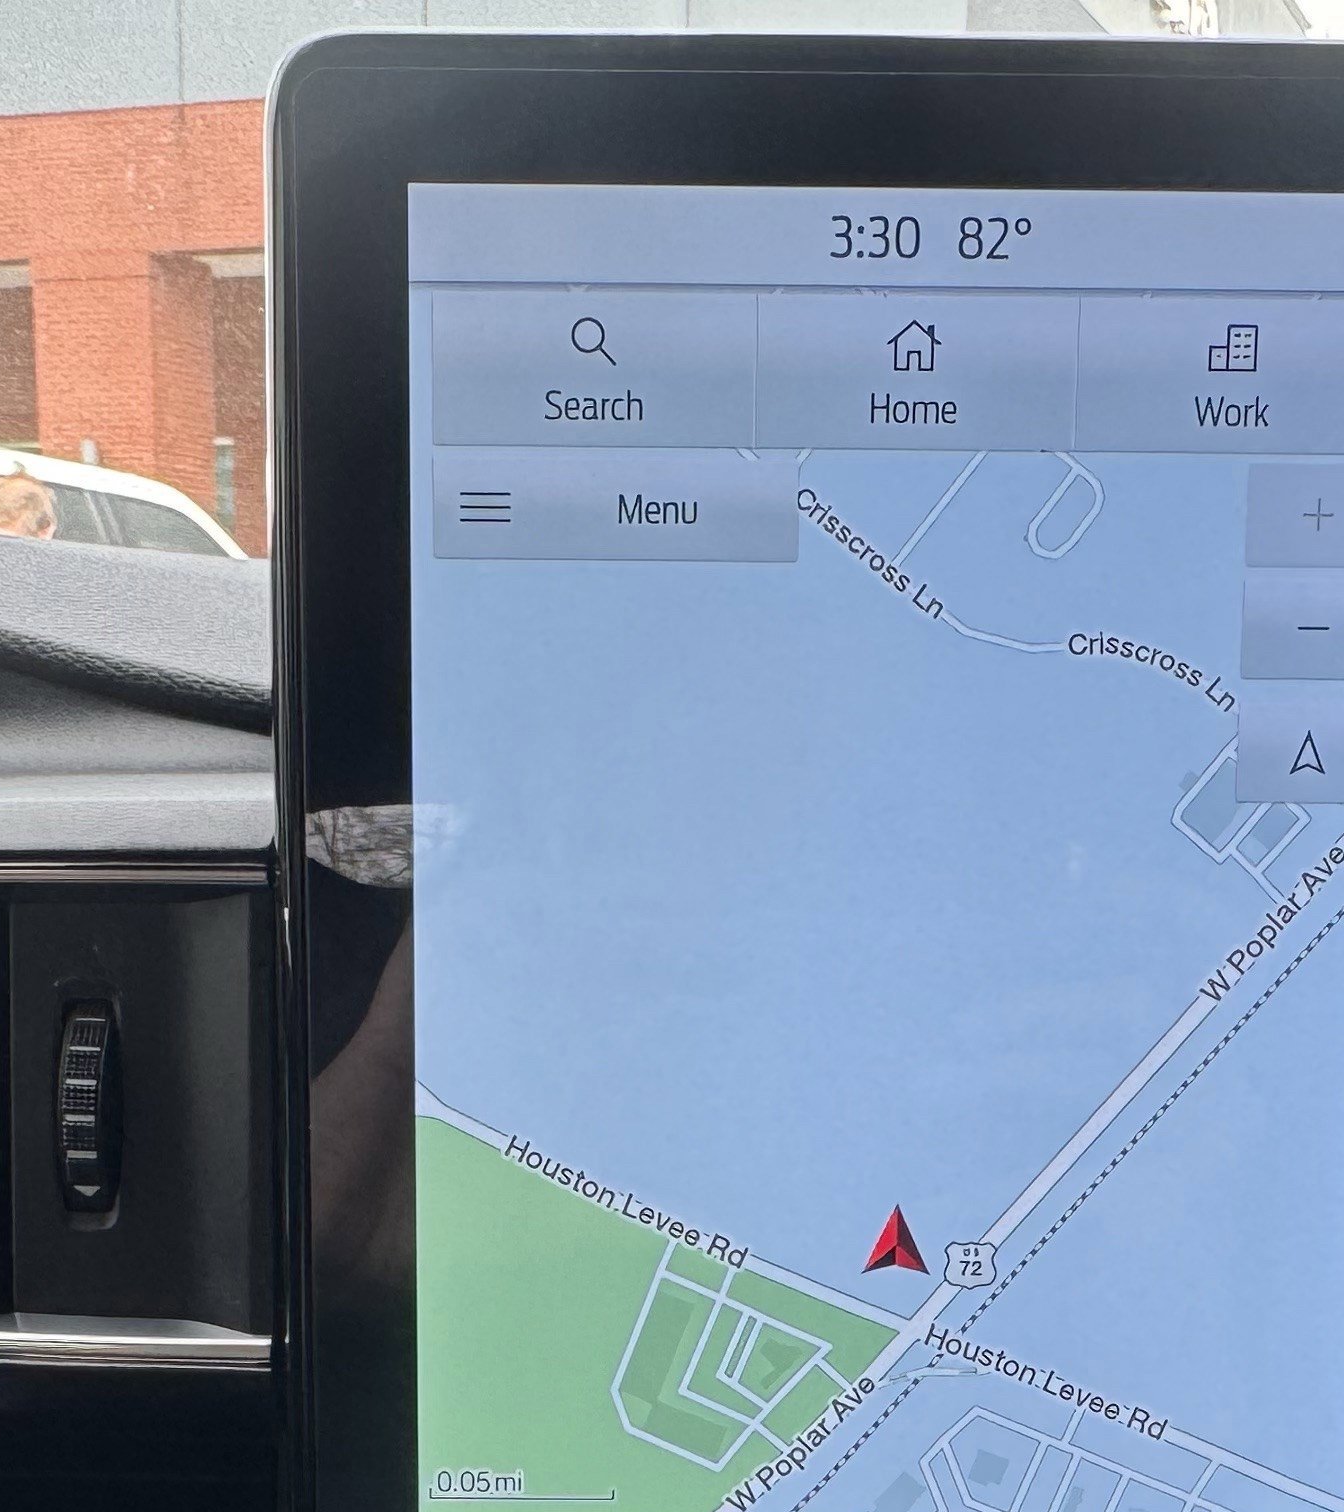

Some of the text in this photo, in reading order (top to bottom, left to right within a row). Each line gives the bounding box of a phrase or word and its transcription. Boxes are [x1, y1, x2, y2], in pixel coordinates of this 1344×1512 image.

[830, 216, 1033, 261] 3:30 82°
[543, 390, 645, 423] Search
[868, 393, 958, 426] Home
[1194, 395, 1270, 428] Work
[617, 493, 699, 527] Menu
[797, 488, 944, 620] Crisscross Ln
[1068, 631, 1236, 713] Crisscross Ln
[1198, 968, 1231, 1002] W
[1226, 892, 1302, 976] Poplar
[504, 1134, 749, 1269] Houston Levee Rd
[959, 1260, 983, 1276] 72
[924, 1323, 1169, 1441] Houston Levee Rd
[756, 1419, 832, 1491] Poplar
[830, 1377, 876, 1426] Ave
